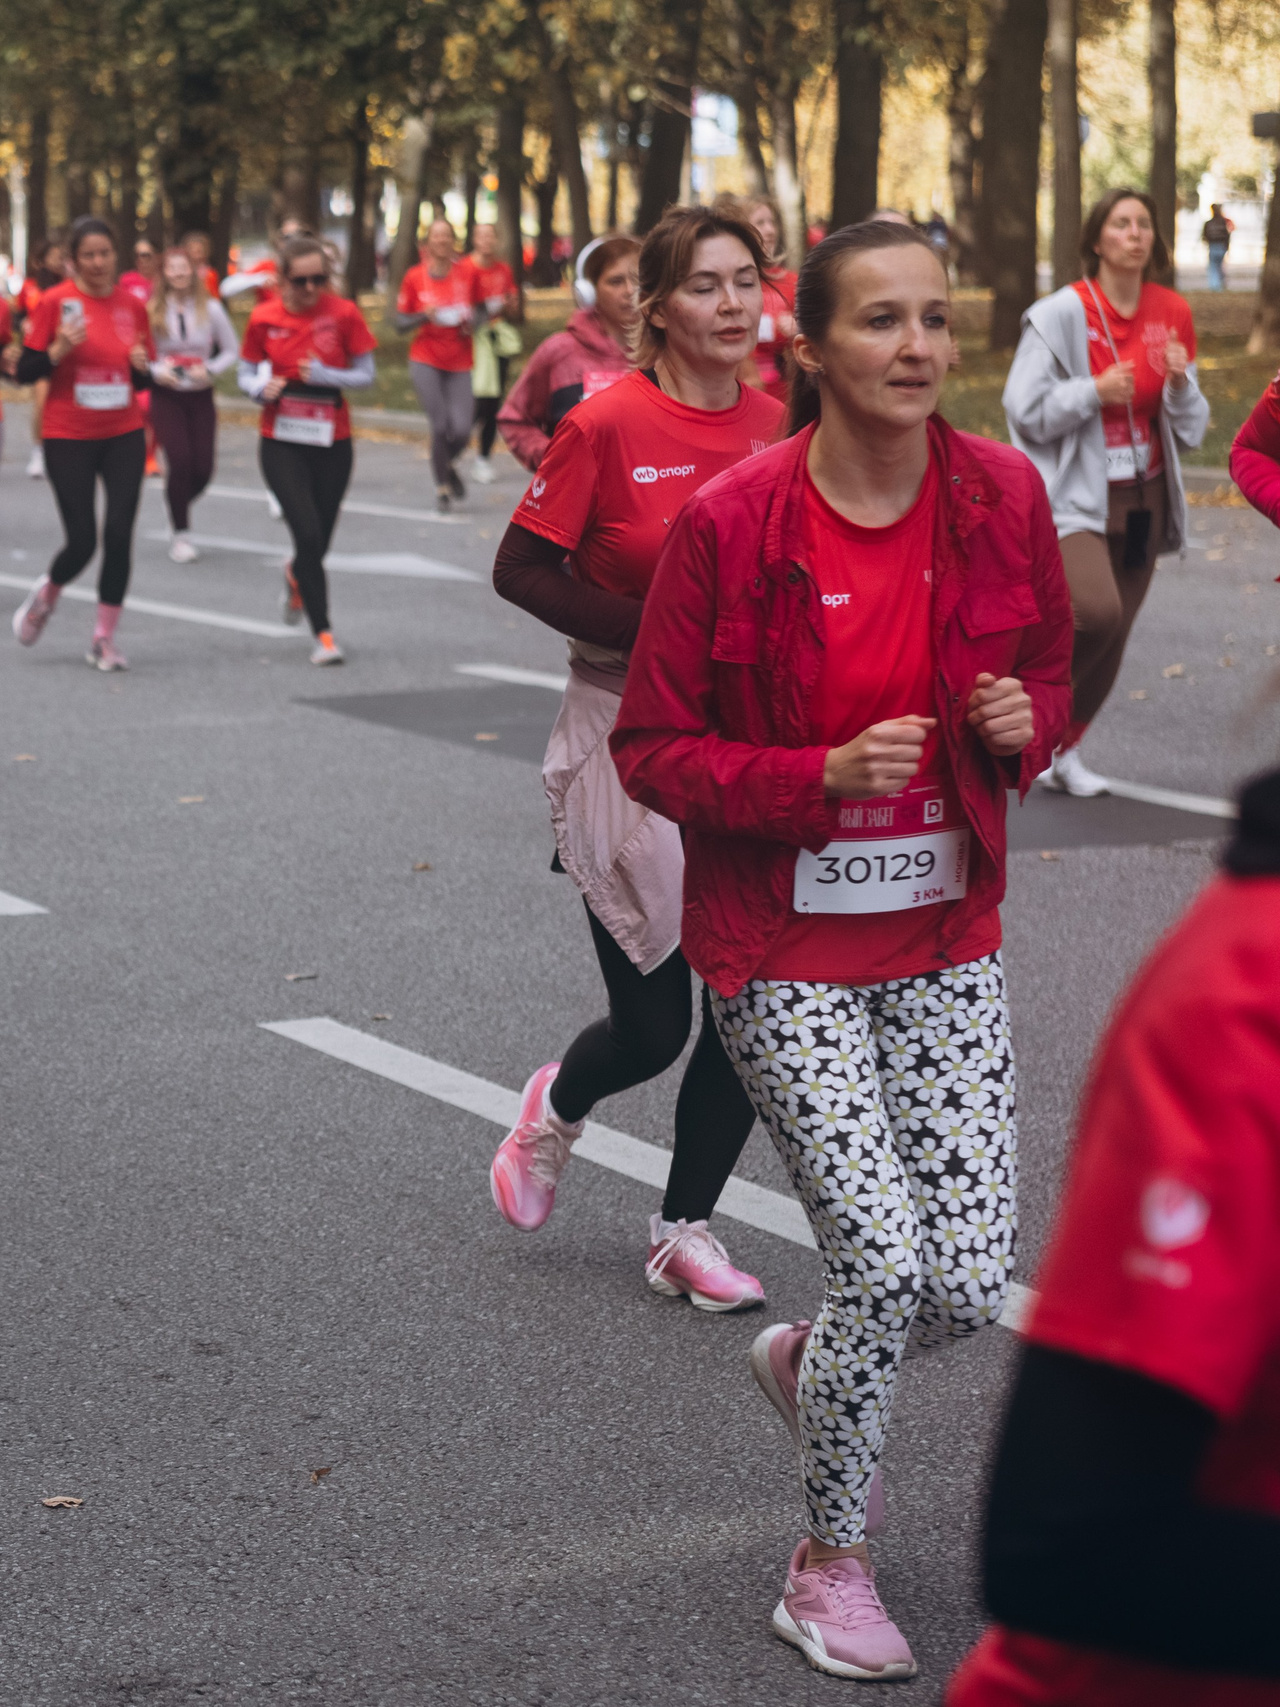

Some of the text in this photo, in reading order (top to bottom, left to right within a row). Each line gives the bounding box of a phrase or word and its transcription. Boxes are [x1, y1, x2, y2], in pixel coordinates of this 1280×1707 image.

[635, 464, 696, 480] wb спорт
[821, 593, 851, 608] орт
[838, 805, 897, 828] ВЫЙ ЗАБЕГ
[815, 850, 936, 884] 30129
[954, 840, 966, 884] МОСКВА
[912, 886, 945, 903] 3 КМ
